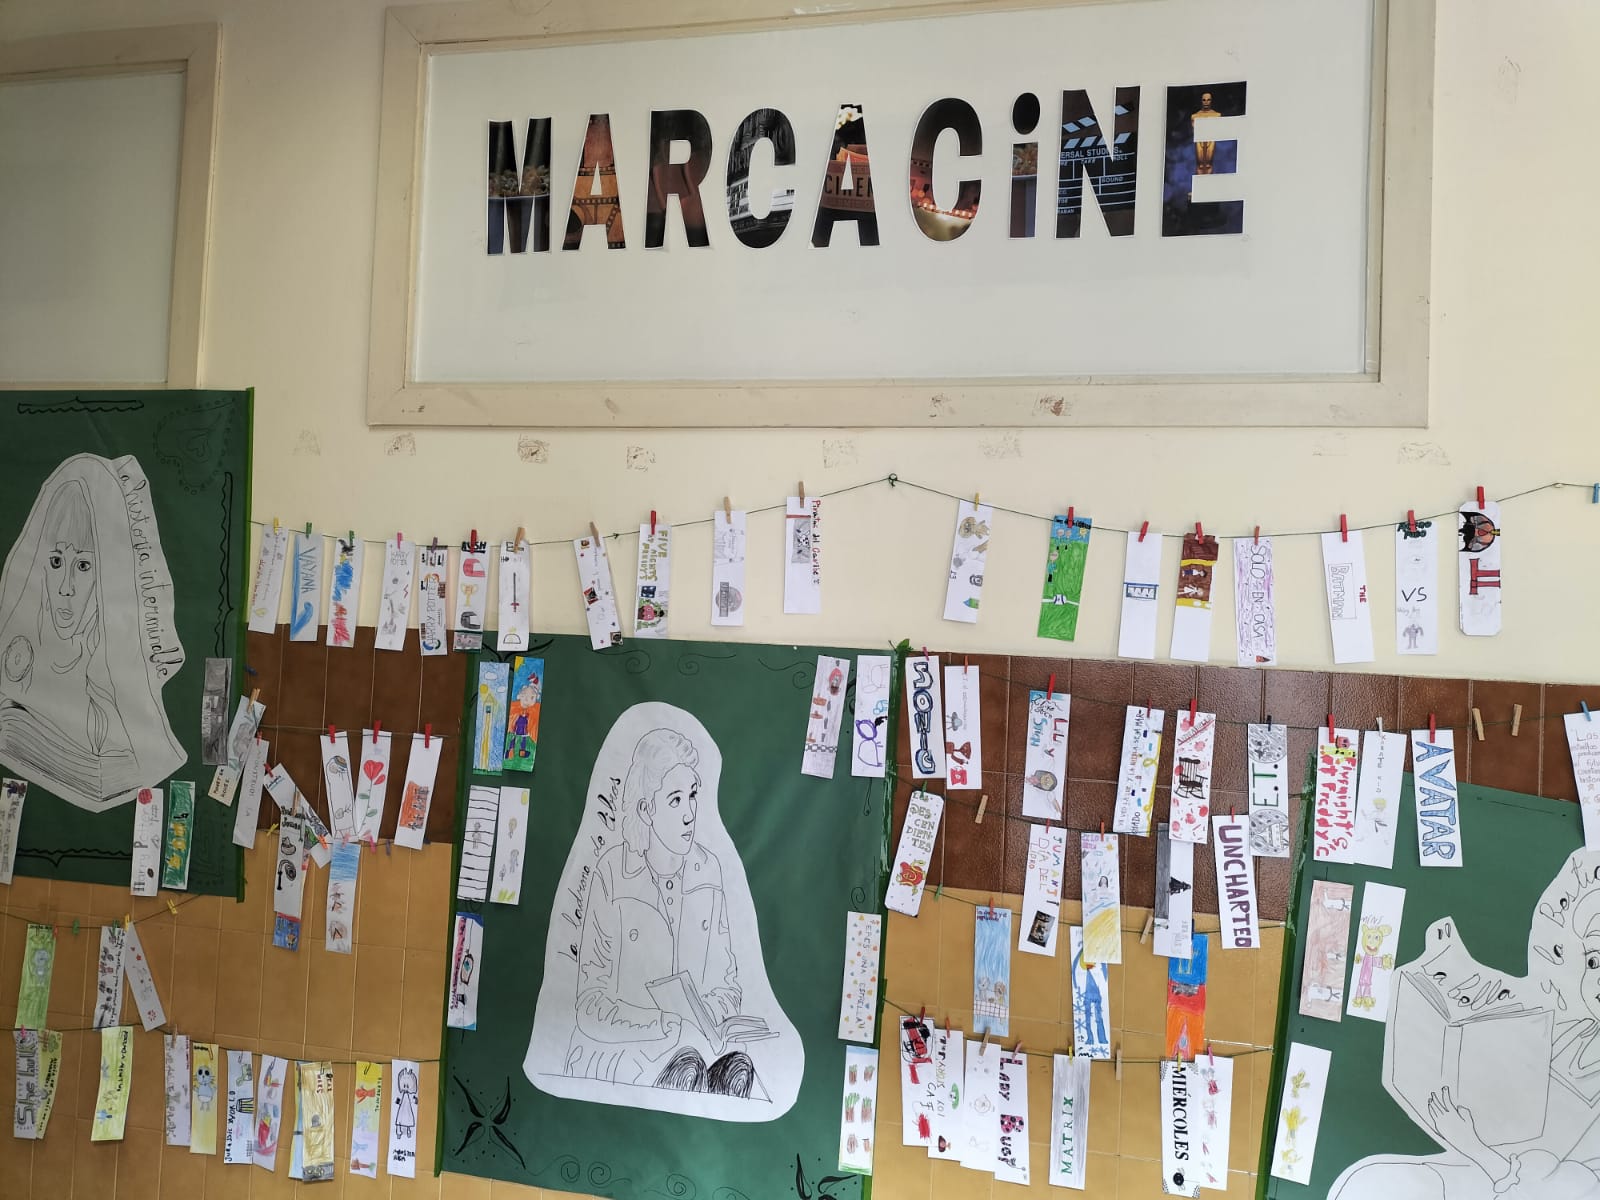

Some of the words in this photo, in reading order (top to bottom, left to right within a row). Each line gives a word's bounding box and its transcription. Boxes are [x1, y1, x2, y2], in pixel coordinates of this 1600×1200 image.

[127, 478, 152, 566] historia
[658, 530, 668, 559] FIVE
[1250, 545, 1266, 580] SOLO
[299, 547, 318, 594] VAYANA
[1330, 565, 1350, 621] BATMAN
[1358, 584, 1367, 603] THE
[1401, 586, 1428, 602] VS
[138, 567, 184, 680] interminable
[912, 660, 936, 775] SONIC
[1415, 740, 1457, 860] AVATAR
[590, 834, 606, 858] de
[1218, 825, 1253, 948] UNCHARTED
[1421, 944, 1448, 987] La
[1532, 943, 1565, 967] la
[1447, 972, 1517, 1012] Bella
[1540, 978, 1568, 1012] y
[1061, 1096, 1075, 1176] MATRIX
